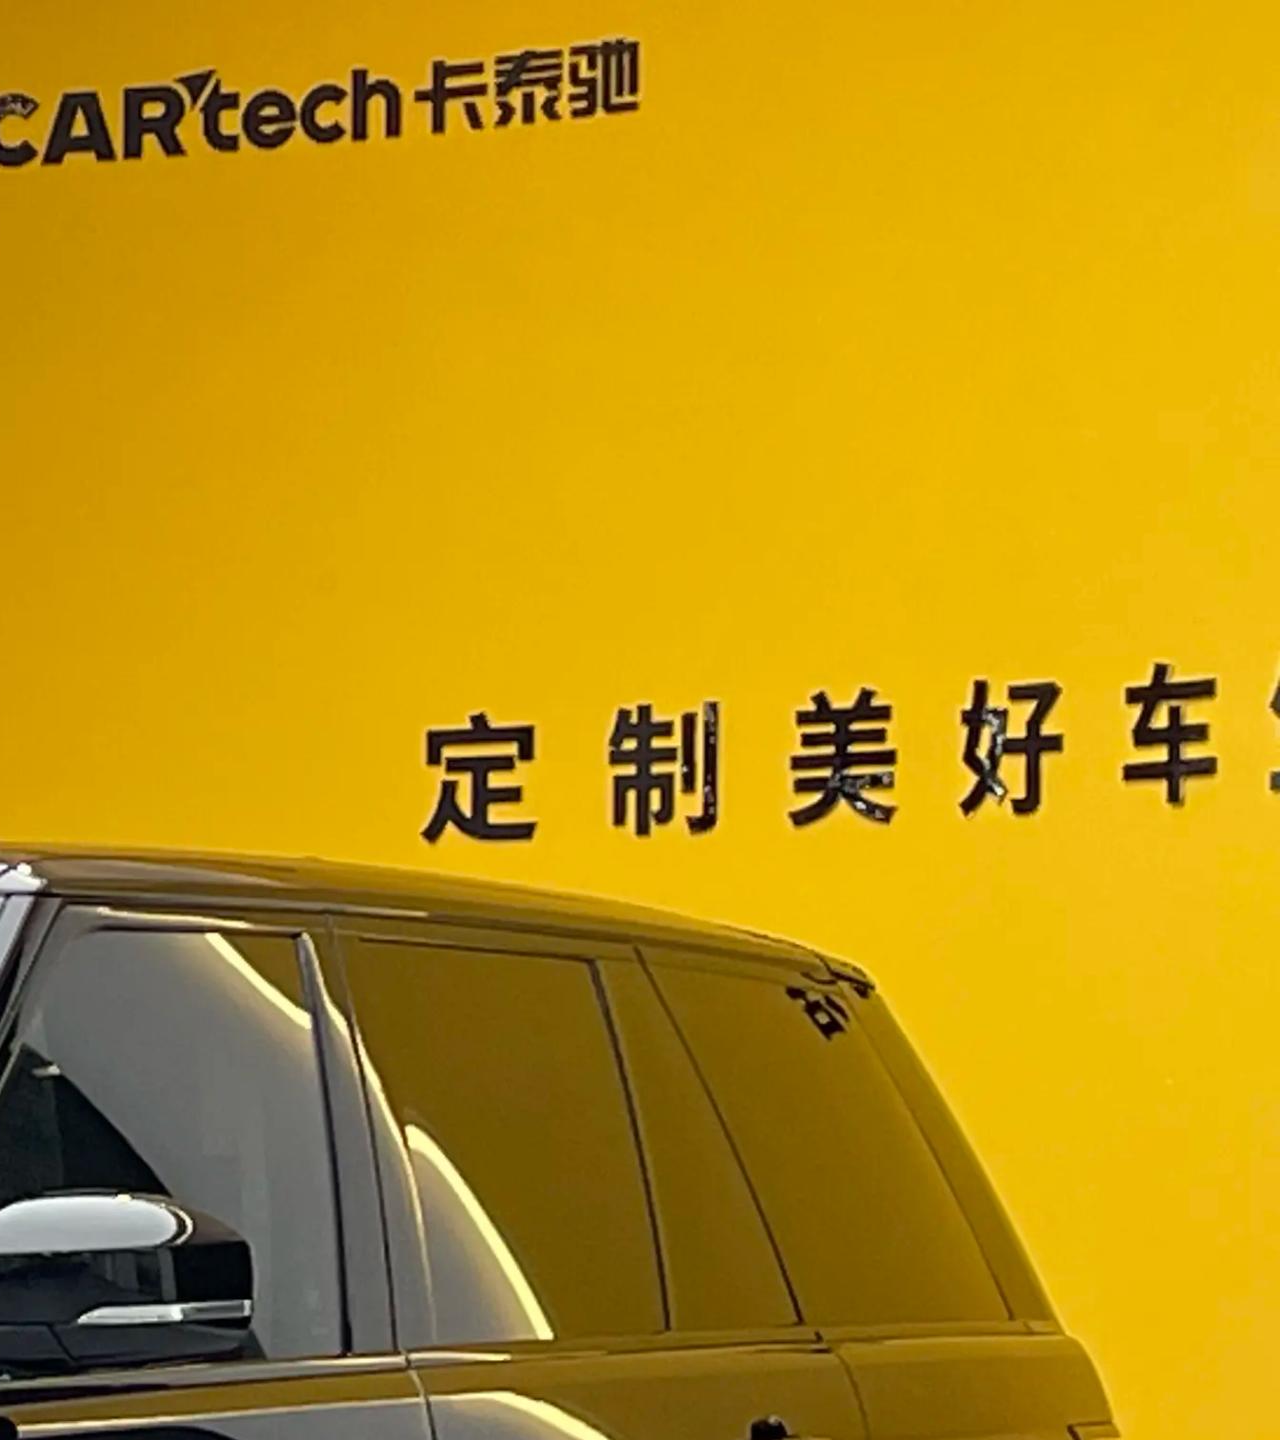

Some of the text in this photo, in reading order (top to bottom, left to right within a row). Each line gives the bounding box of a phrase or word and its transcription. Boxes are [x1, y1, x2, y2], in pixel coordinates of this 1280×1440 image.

[414, 39, 640, 134] 卡泰驰
[420, 662, 1280, 845] 定制美好车
